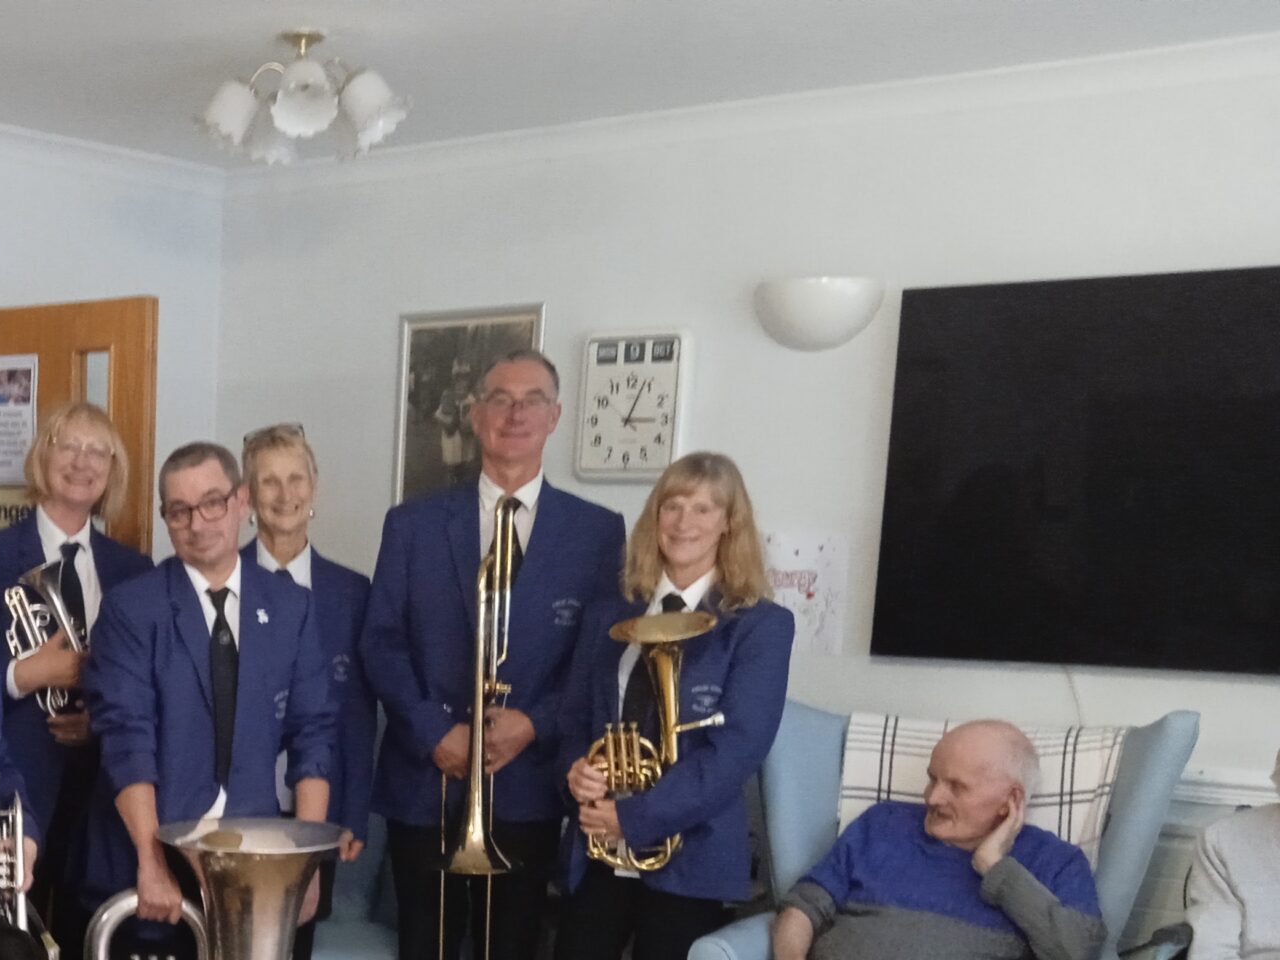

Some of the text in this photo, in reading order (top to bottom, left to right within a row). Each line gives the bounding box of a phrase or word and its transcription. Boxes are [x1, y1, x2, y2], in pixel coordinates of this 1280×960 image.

[611, 381, 620, 395] 11
[627, 375, 638, 389] 12
[597, 395, 608, 409] 10
[657, 394, 664, 408] 2
[590, 414, 598, 428] 9
[661, 413, 669, 426] 3
[594, 433, 602, 447] 8
[653, 432, 661, 445] 4
[607, 446, 613, 460] 7
[622, 451, 630, 465] 6
[640, 446, 648, 461] 5
